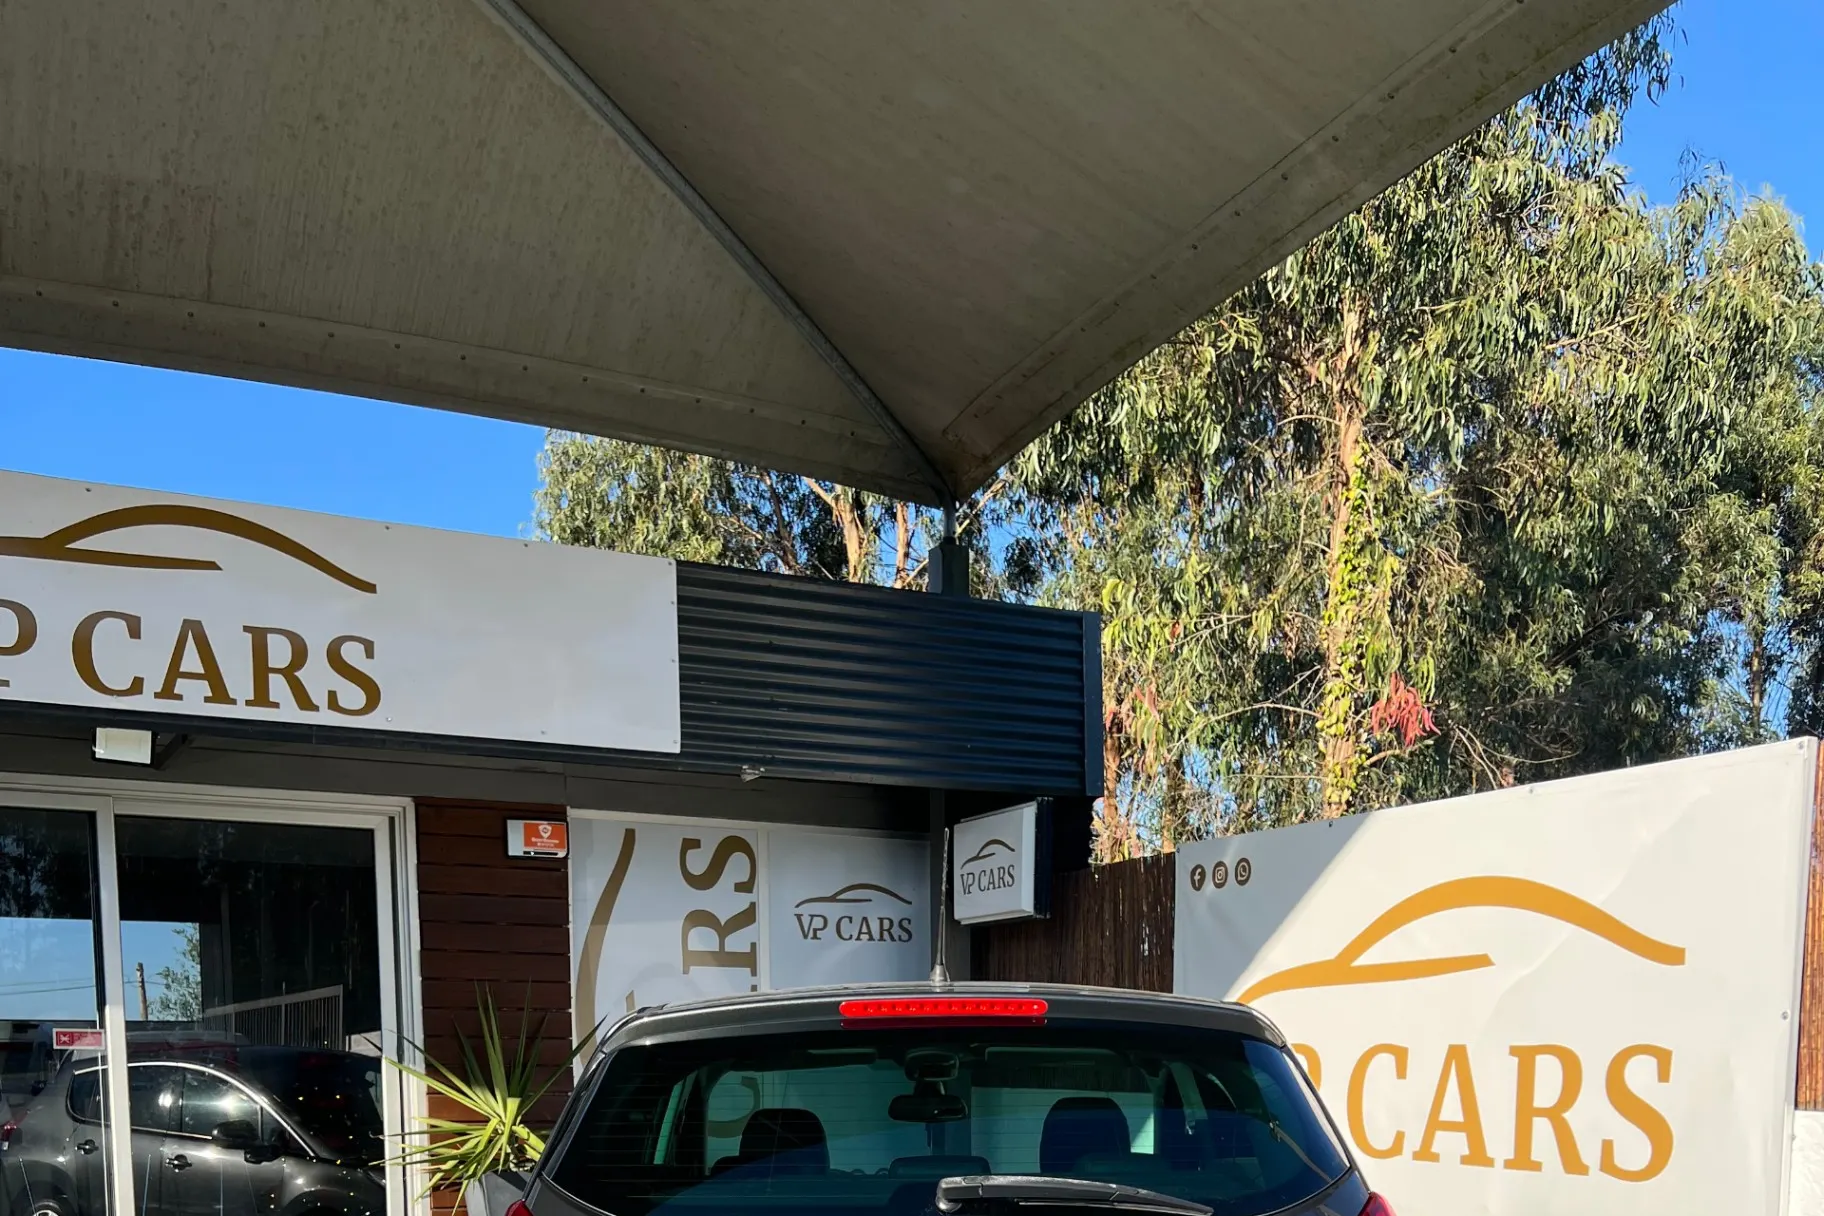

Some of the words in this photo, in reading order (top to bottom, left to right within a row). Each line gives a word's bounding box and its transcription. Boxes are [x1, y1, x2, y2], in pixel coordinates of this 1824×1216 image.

[71, 610, 382, 717] CARS
[960, 872, 976, 895] VP
[978, 864, 1015, 892] CARS
[794, 913, 829, 940] VP
[835, 915, 913, 943] CARS
[1346, 1043, 1674, 1183] CARS
